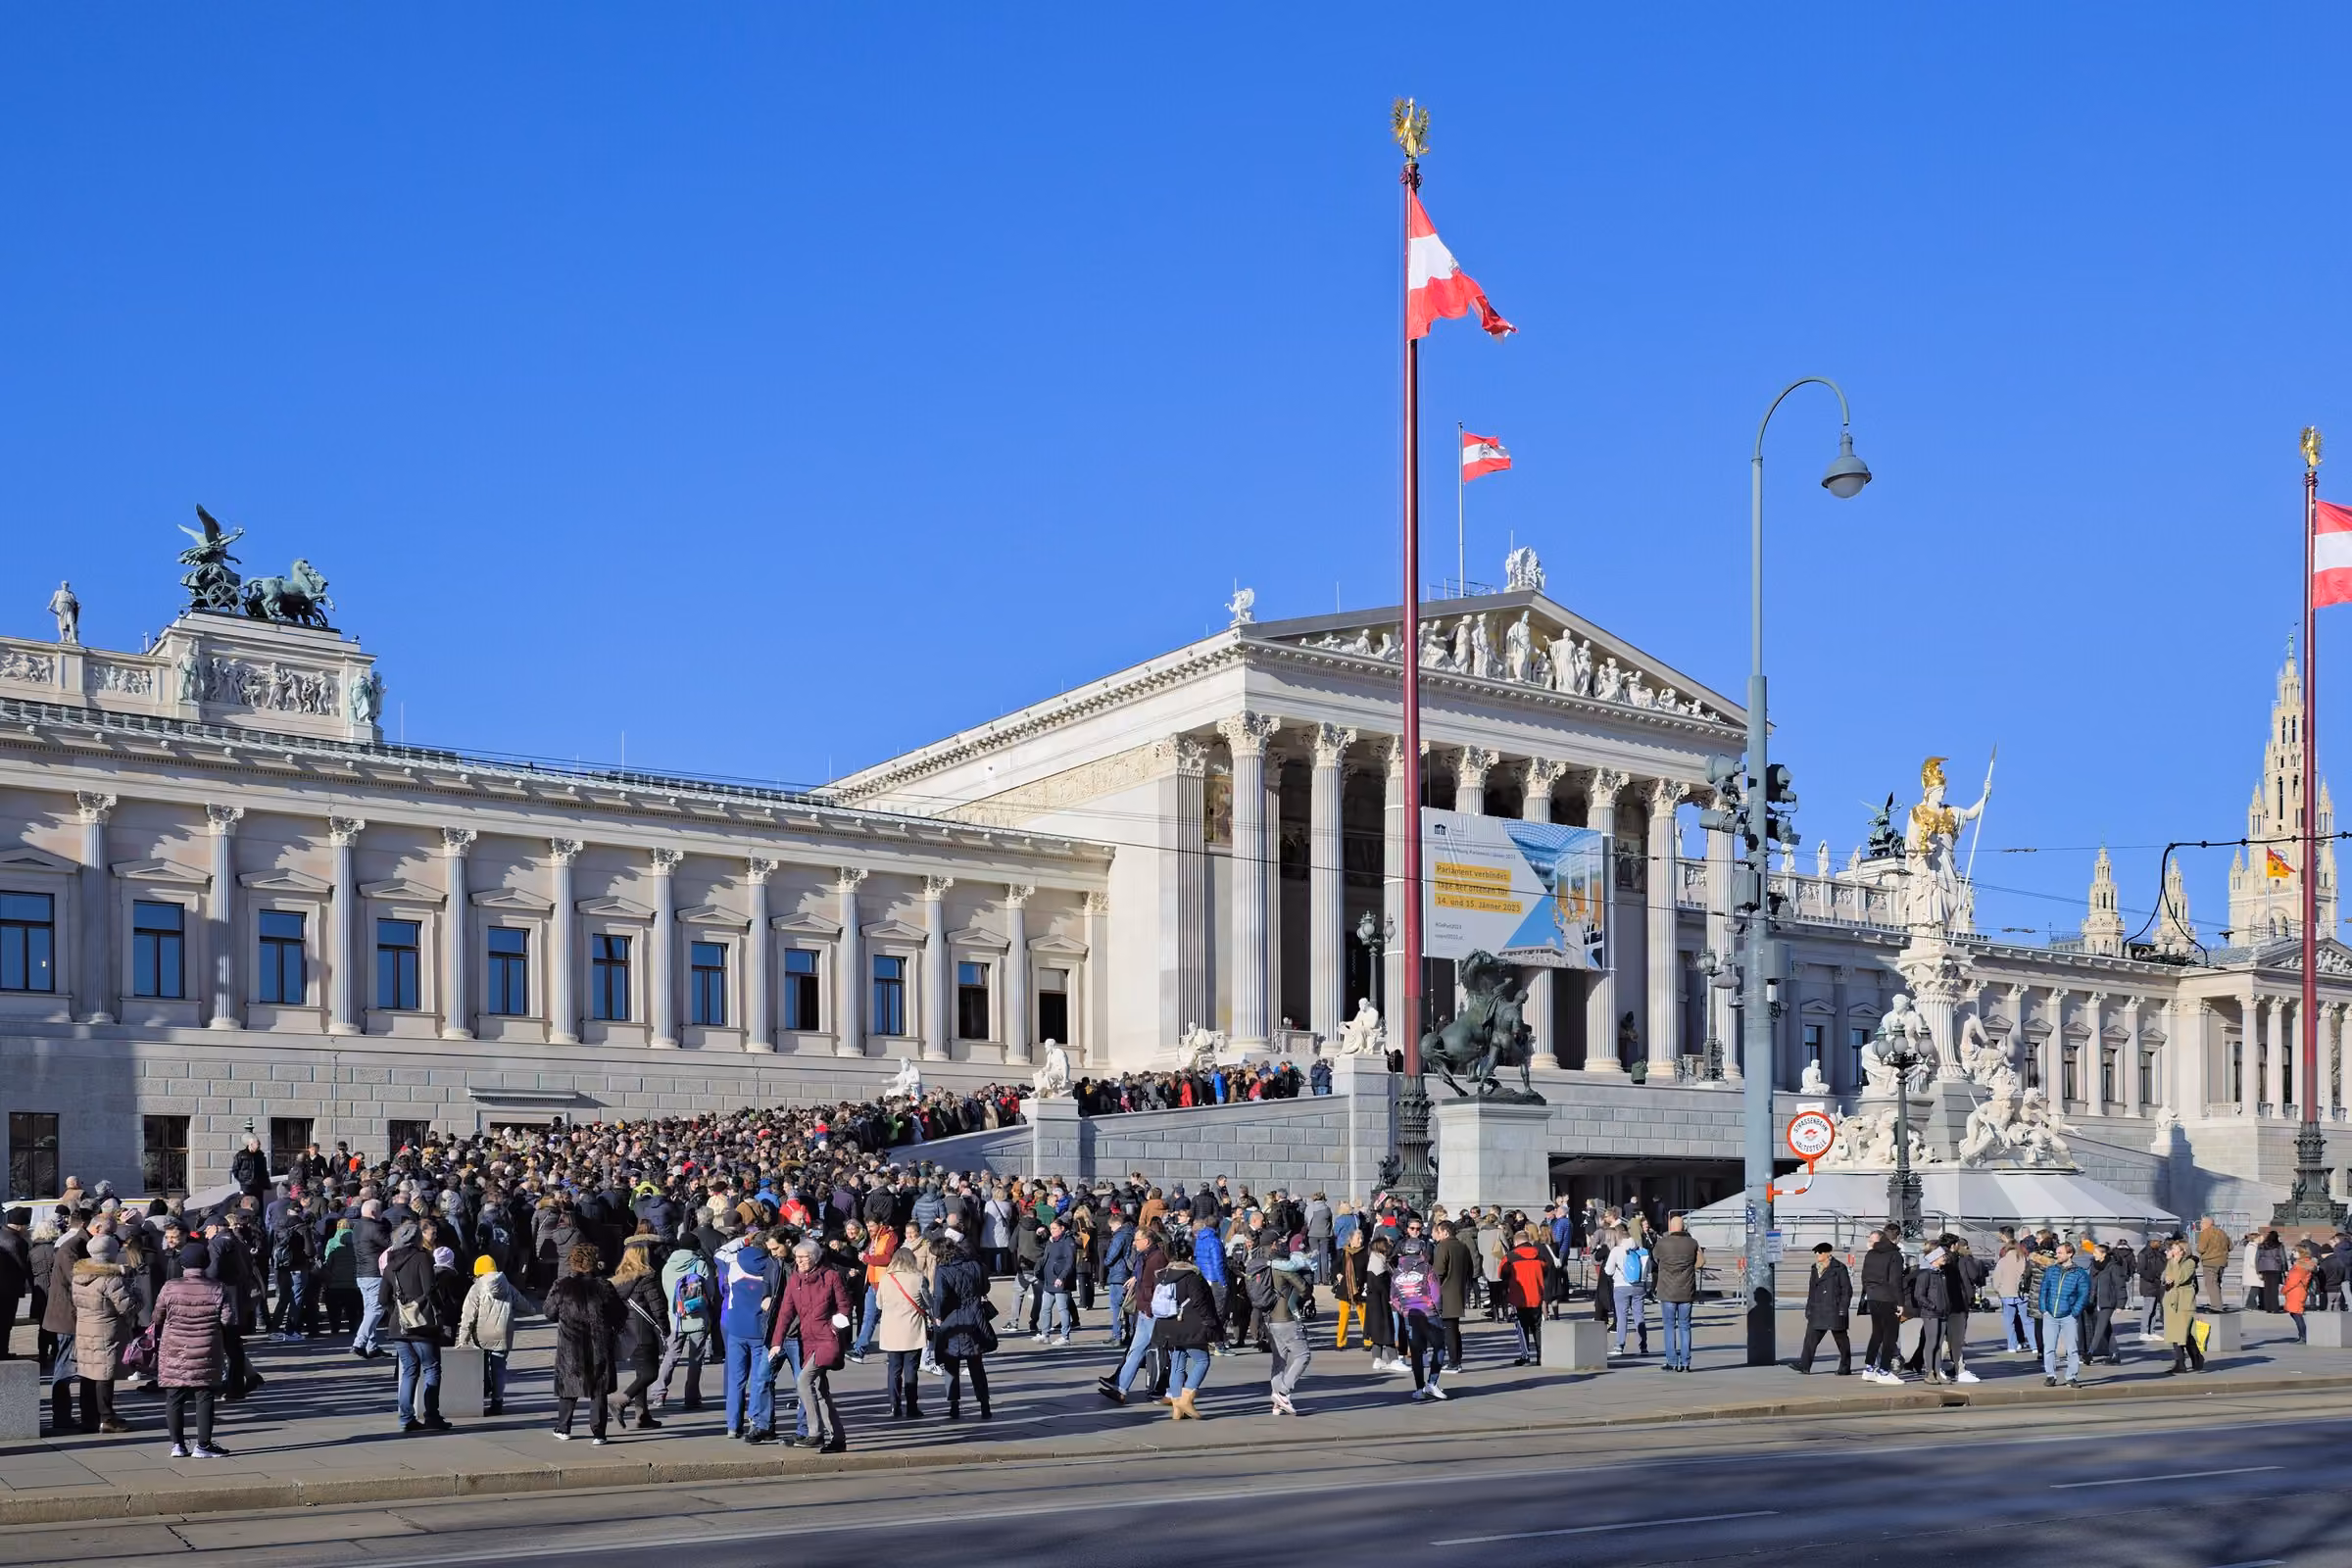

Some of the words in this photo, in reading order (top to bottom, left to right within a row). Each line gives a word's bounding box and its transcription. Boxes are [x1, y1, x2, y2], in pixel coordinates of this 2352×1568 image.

[1437, 864, 1472, 877] Parlament
[1438, 881, 1452, 891] Tage
[1454, 882, 1467, 892] der
[1438, 896, 1448, 905] 14.
[1450, 897, 1464, 906] und
[1478, 900, 1501, 910] Jänner
[1502, 903, 1521, 912] 2023
[1794, 1117, 1828, 1133] STRASSENBAHN
[1795, 1139, 1827, 1152] HALTESTELLE
